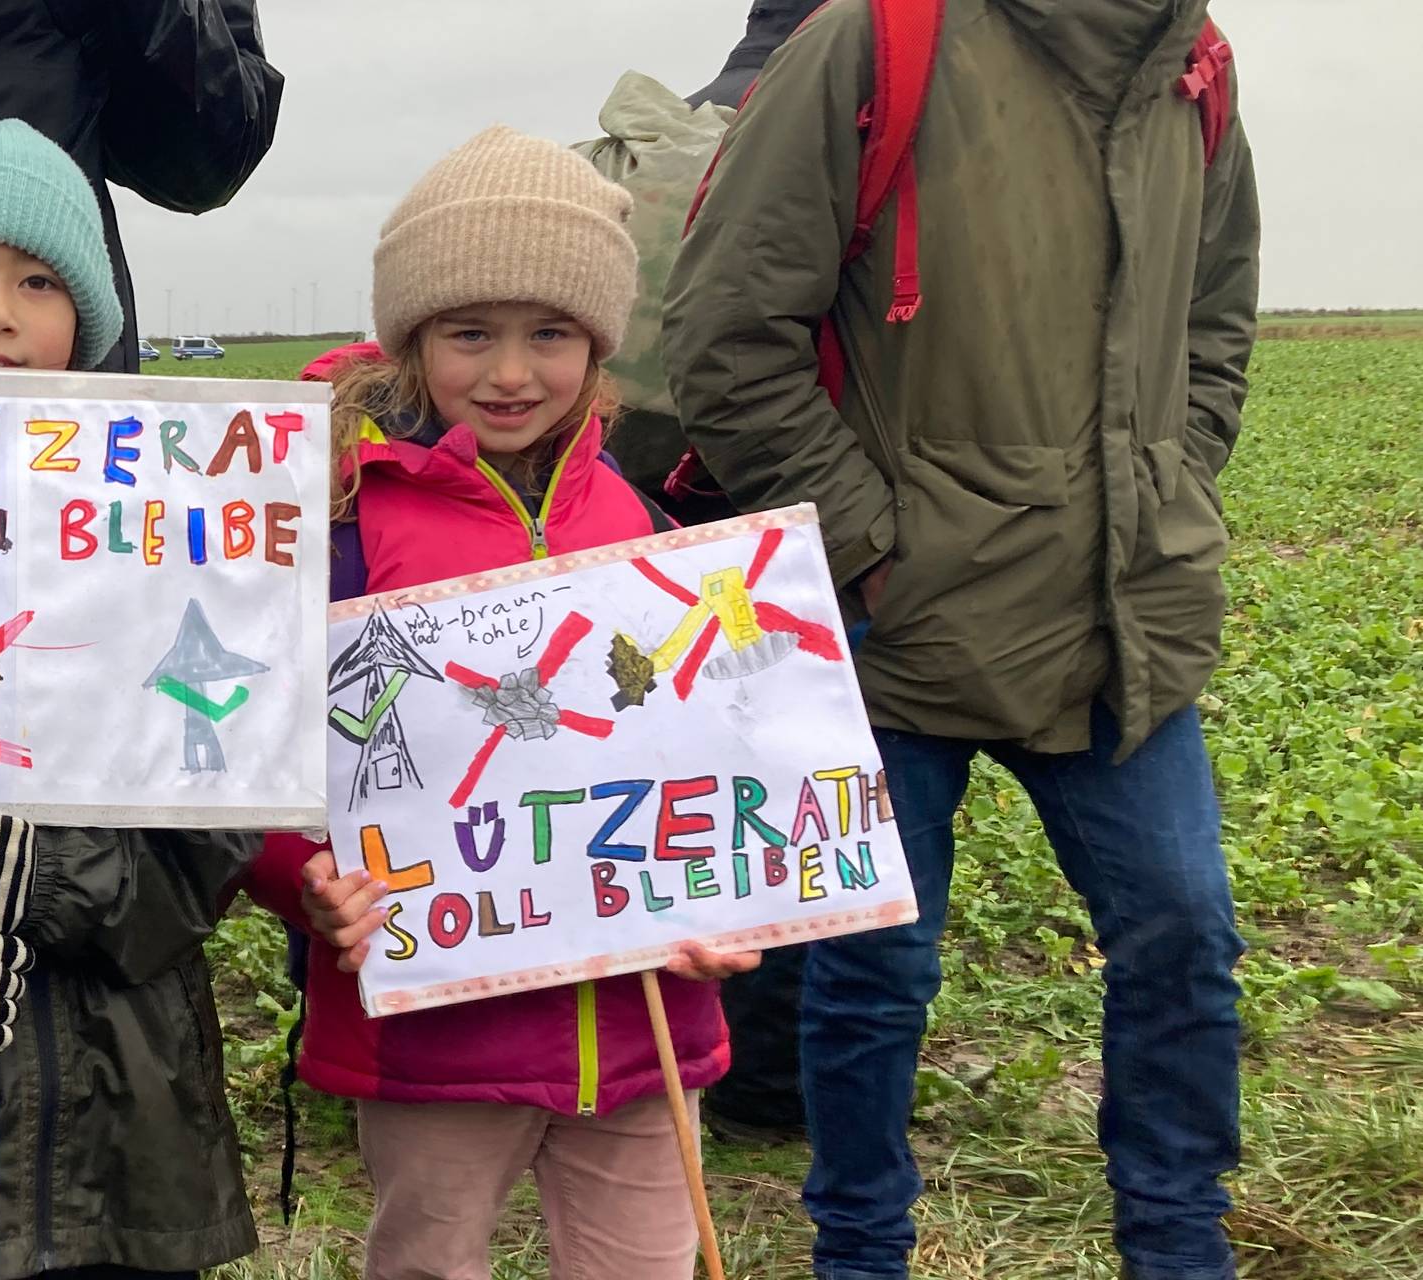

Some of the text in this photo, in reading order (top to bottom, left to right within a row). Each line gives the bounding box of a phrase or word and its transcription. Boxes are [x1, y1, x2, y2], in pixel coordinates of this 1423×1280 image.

[60, 499, 301, 567] BLEIBE
[359, 765, 895, 894] LÜTZERATH
[385, 841, 880, 960] SOLL BLEIBEN
